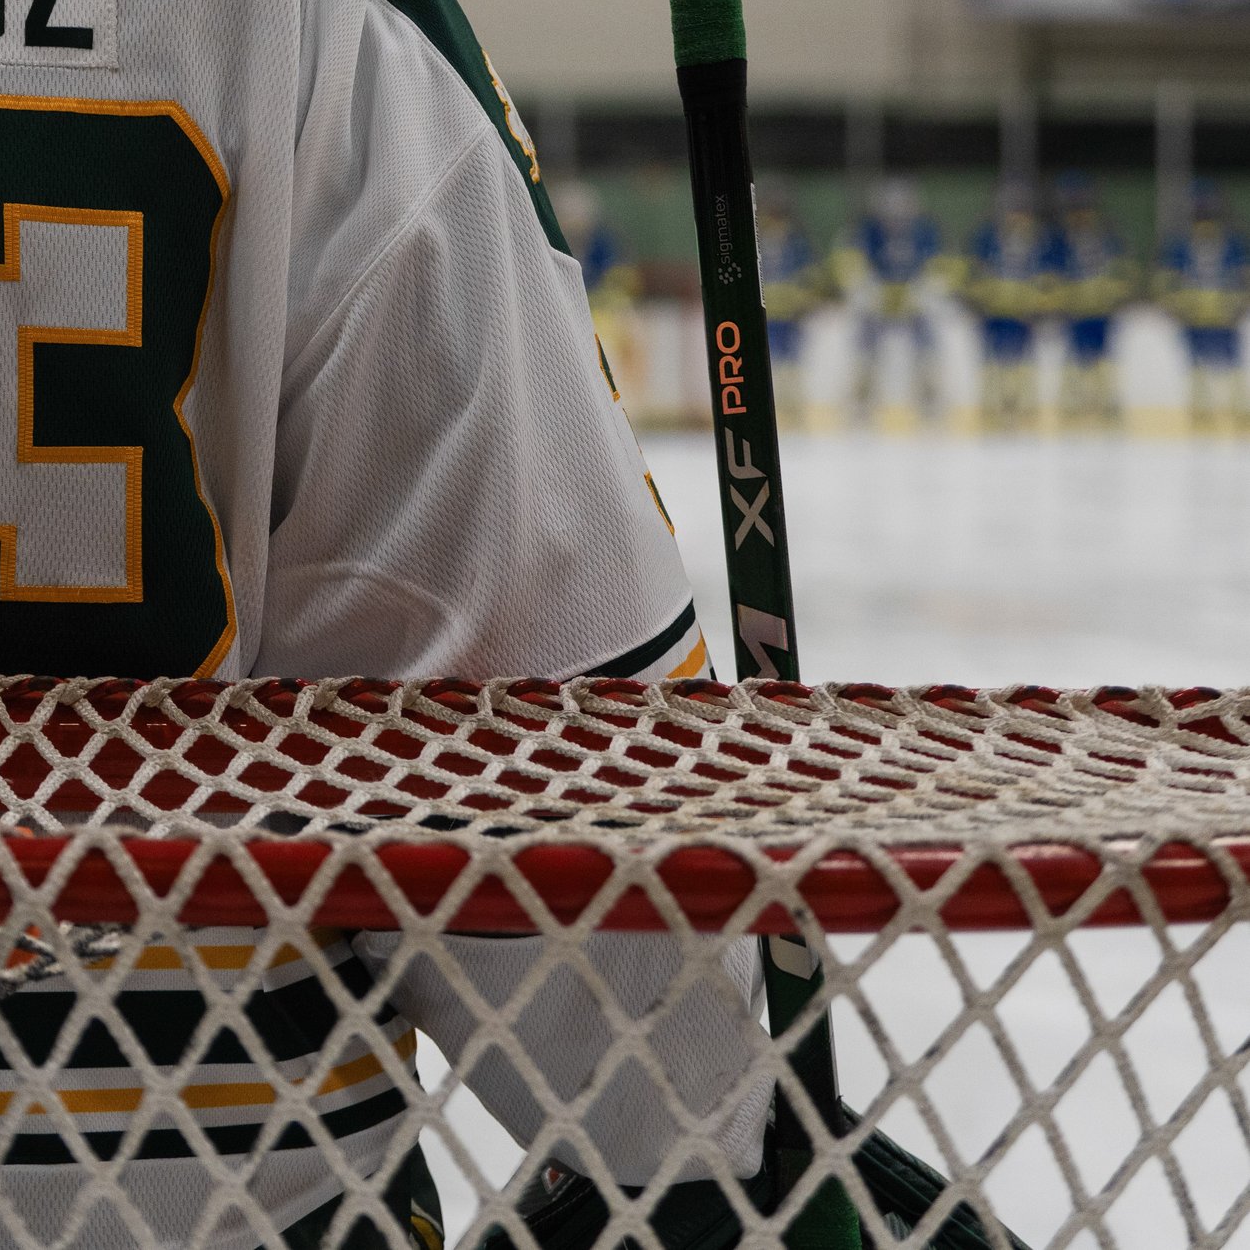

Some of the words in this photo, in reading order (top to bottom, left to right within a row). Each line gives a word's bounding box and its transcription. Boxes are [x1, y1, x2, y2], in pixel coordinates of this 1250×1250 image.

[715, 194, 733, 264] sigmatex
[715, 321, 747, 415] PRO
[724, 426, 775, 551] XF
